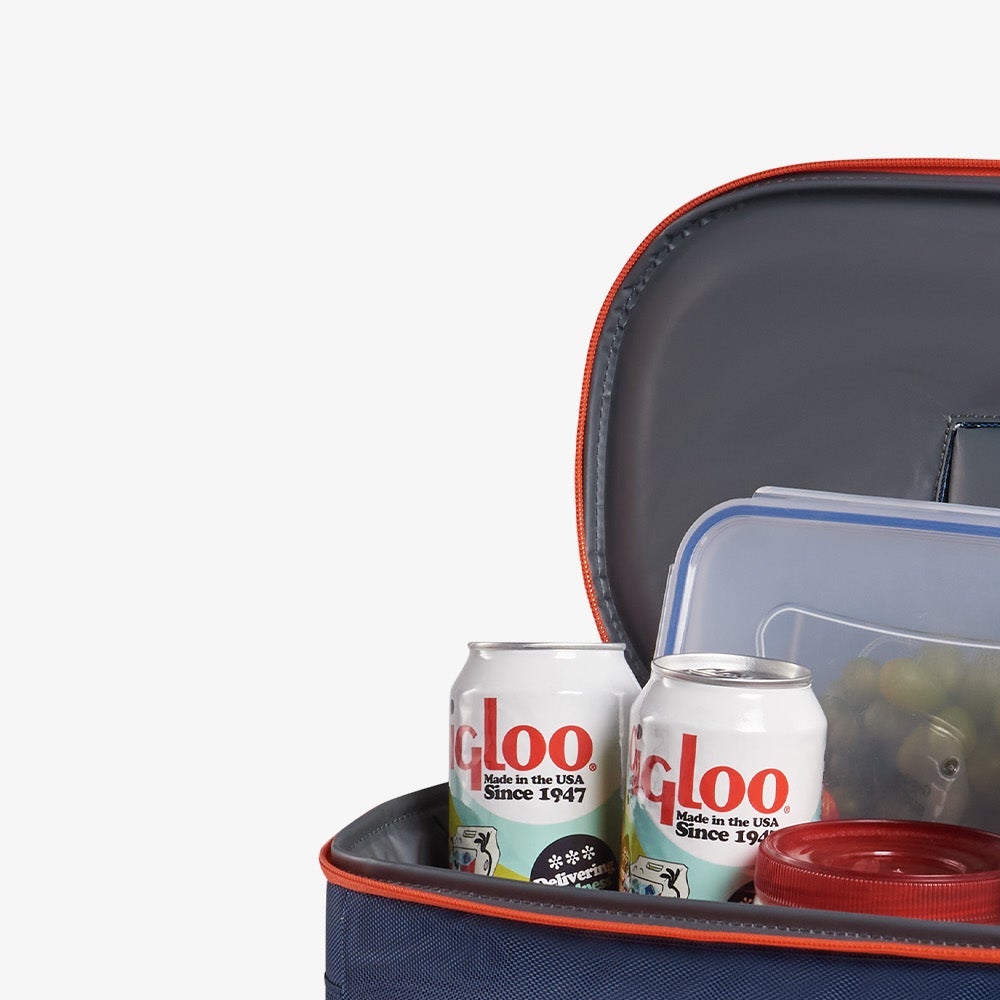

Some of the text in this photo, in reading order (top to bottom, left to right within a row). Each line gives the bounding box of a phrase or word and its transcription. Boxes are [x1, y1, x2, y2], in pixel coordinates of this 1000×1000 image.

[484, 774, 584, 784] Made in the USA
[484, 785, 586, 803] Since 1947
[676, 810, 779, 828] Made in the USA
[675, 821, 729, 841] Since
